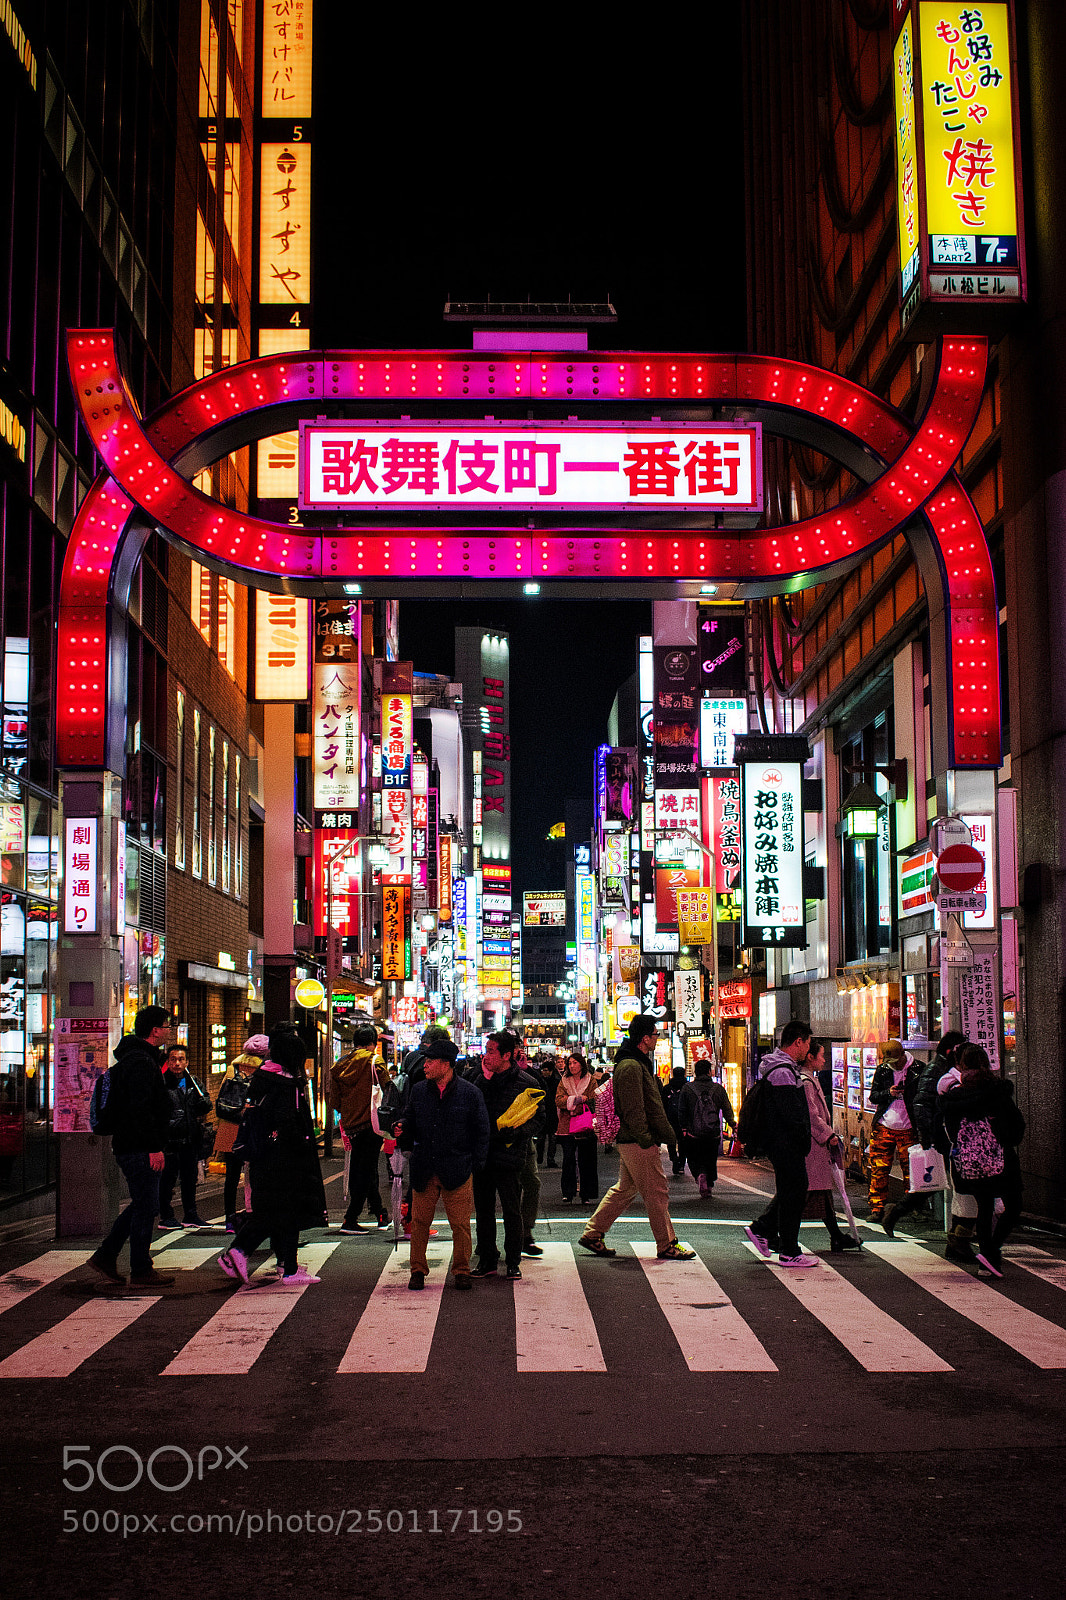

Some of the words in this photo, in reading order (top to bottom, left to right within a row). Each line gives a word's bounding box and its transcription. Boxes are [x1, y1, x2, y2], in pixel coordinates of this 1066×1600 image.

[960, 9, 1003, 87] お好み
[936, 20, 989, 125] もんじゃ
[931, 81, 966, 131] たこ
[292, 126, 303, 141] 5
[943, 138, 995, 226] 焼き
[270, 179, 301, 300] すずや
[980, 237, 1008, 263] 7F
[943, 276, 1006, 295] 小松ビル
[289, 311, 301, 327] 4
[321, 438, 741, 496] 歌舞伎町一番街
[288, 507, 299, 523] 3
[701, 621, 718, 632] 4F
[322, 644, 352, 656] 3F
[320, 704, 342, 779] バンタイ
[345, 705, 354, 774] タイ国料理専門店
[388, 698, 405, 769] まぐろ商店
[712, 712, 727, 766] 東南荘
[384, 774, 408, 785] B1F
[328, 797, 345, 805] 3F
[659, 794, 698, 813] 焼肉
[322, 813, 352, 828] 焼肉
[719, 780, 740, 889] 焼鳥釜めし
[754, 790, 780, 916] お好み焼本陣
[72, 826, 91, 923] 劇場通り
[389, 875, 404, 884] 4F
[680, 892, 708, 901] 悪質な
[680, 903, 708, 912] 客引き
[940, 898, 982, 908] 自転車を除く
[681, 914, 709, 922] に注意
[762, 927, 786, 941] 2F
[973, 964, 987, 1050] 防犯カメラ作動中
[983, 958, 995, 1056] みなさまの安全を守ります
